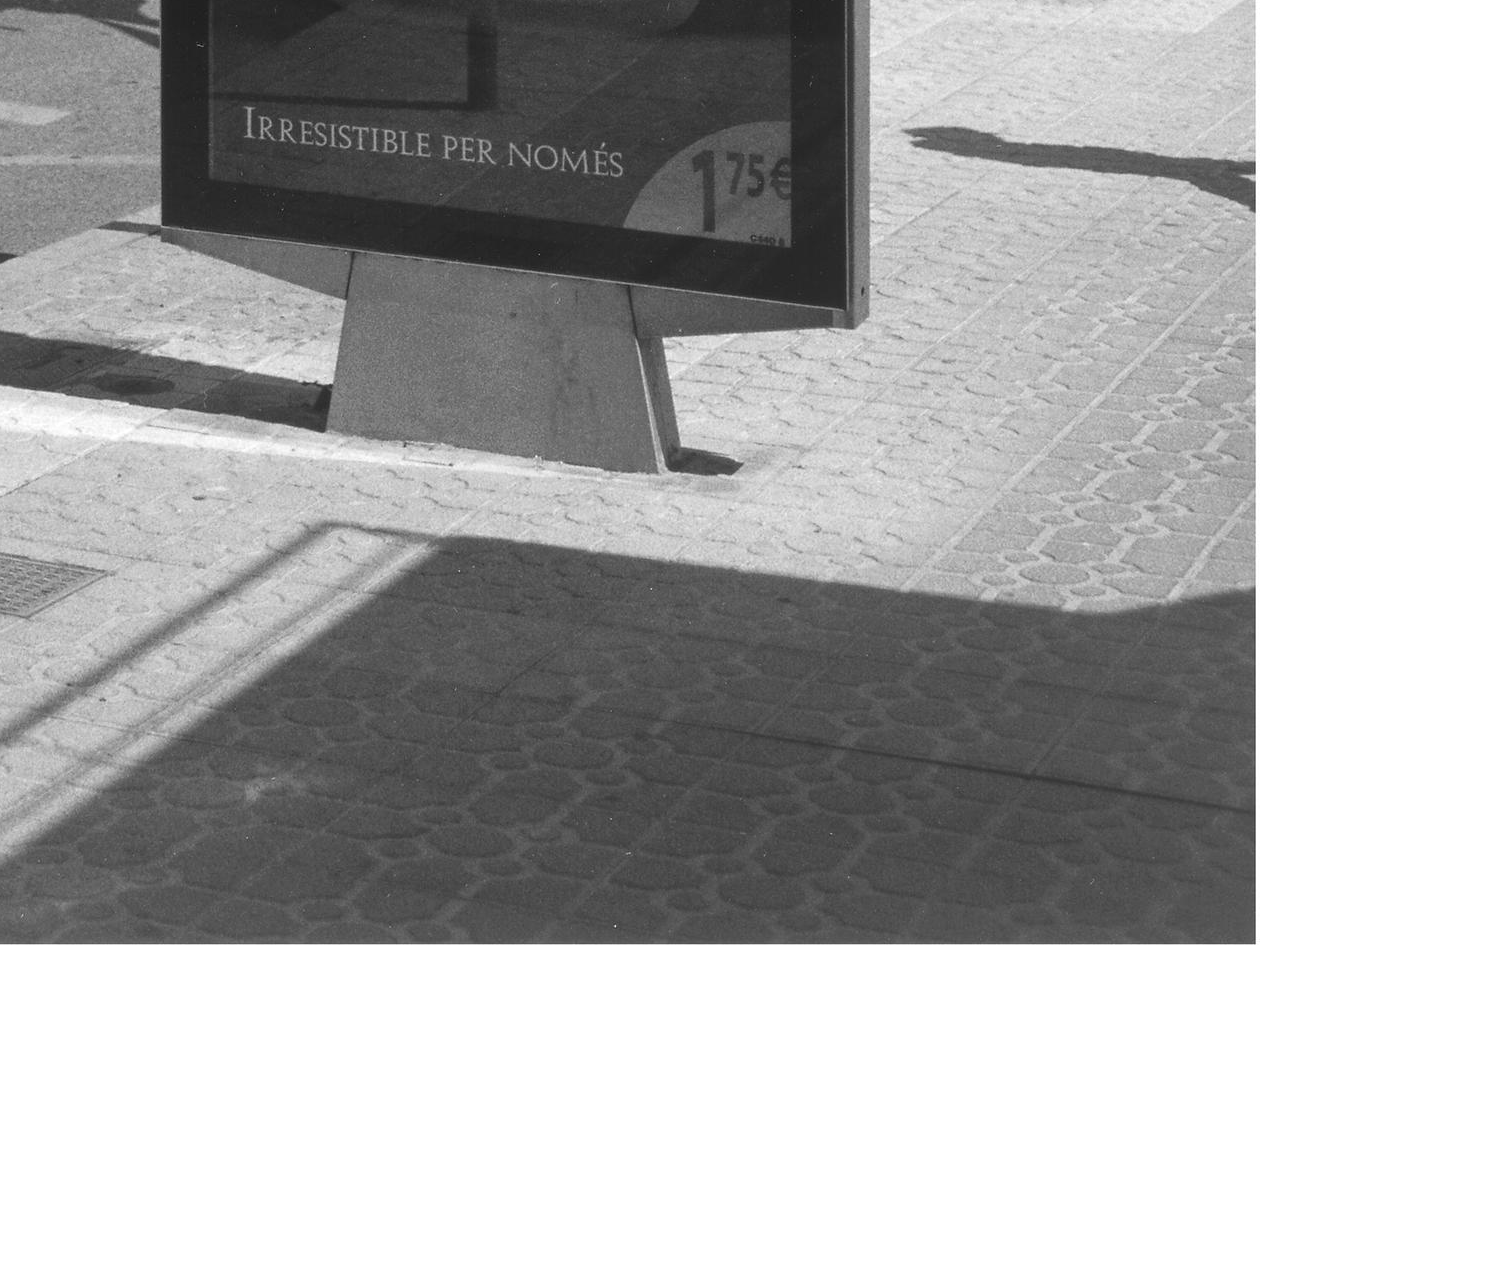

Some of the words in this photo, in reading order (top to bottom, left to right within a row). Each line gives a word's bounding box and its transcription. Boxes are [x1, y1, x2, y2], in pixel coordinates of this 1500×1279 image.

[243, 105, 432, 158] IRRESISTIBLE
[442, 134, 497, 166] PER
[508, 141, 624, 179] NOMÉS
